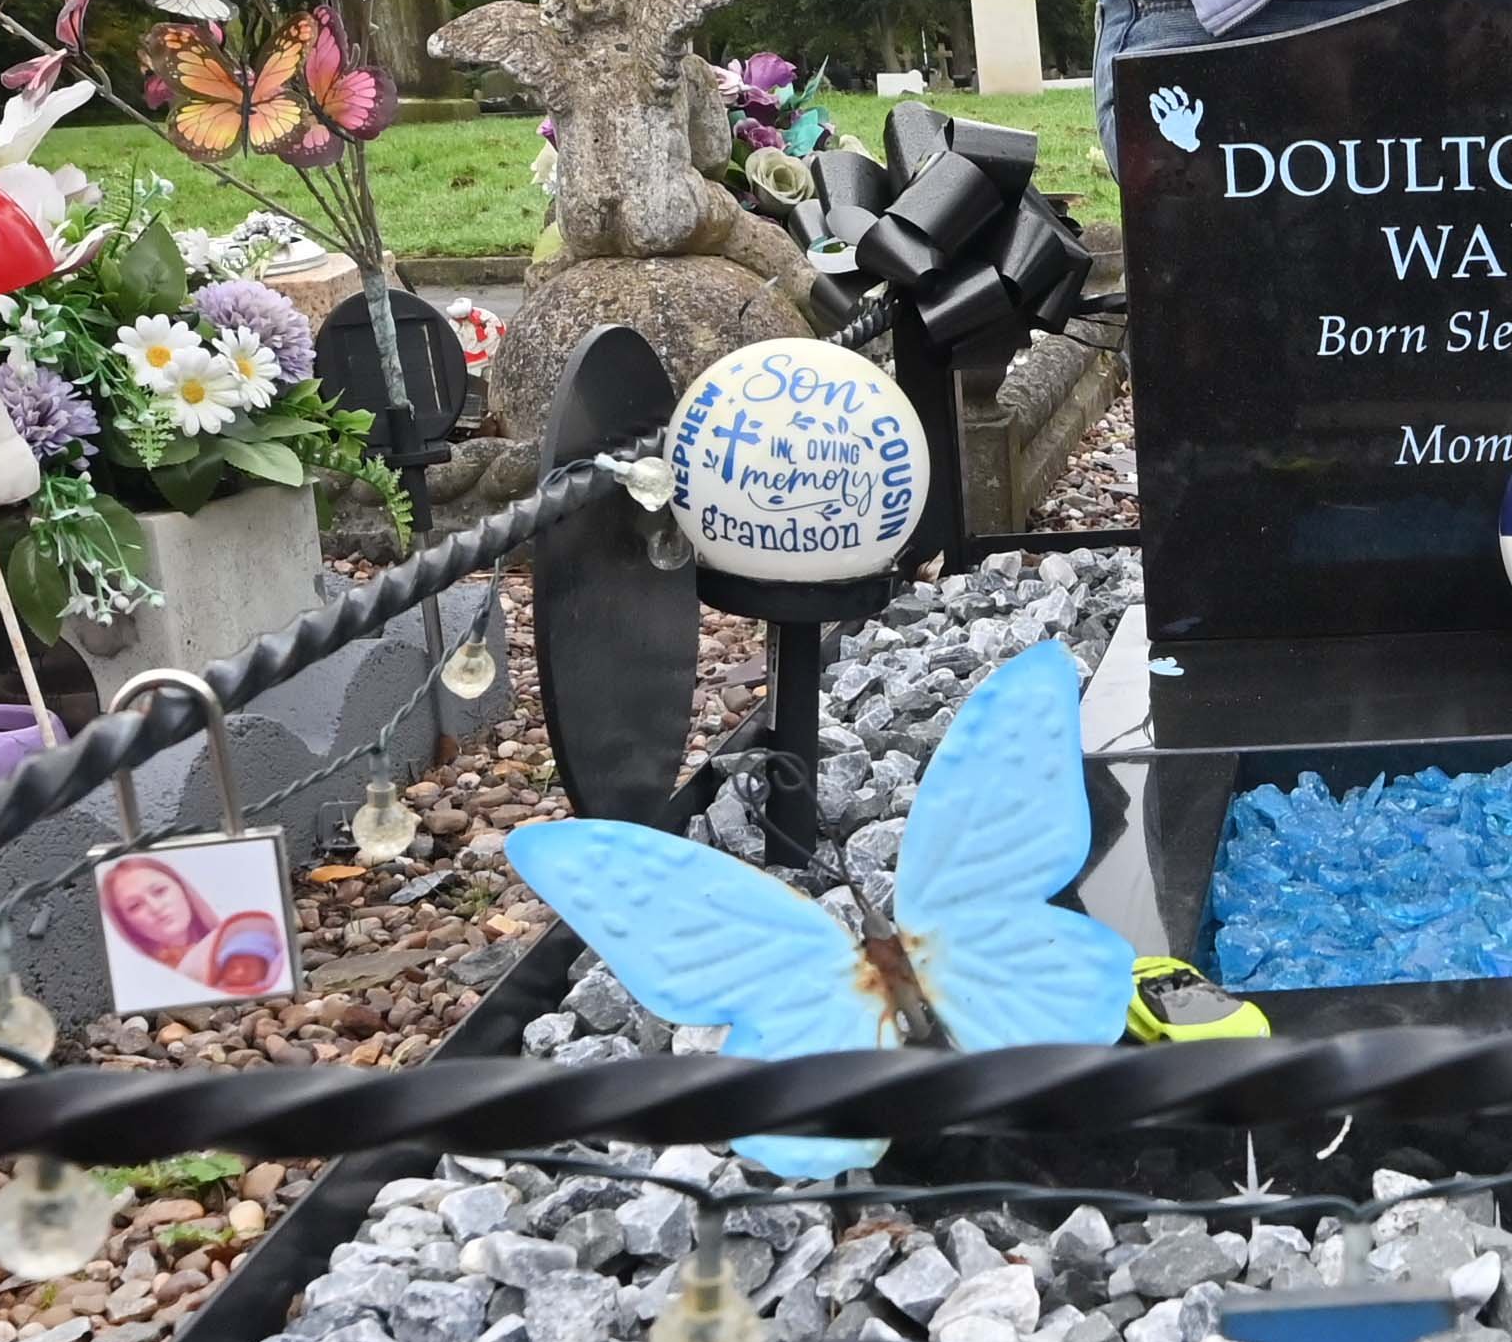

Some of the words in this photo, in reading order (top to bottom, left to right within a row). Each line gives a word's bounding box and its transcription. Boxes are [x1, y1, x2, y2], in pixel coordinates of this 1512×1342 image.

[1317, 315, 1427, 356] Born
[743, 354, 864, 414] Son
[672, 381, 723, 510] NEPHEW
[740, 465, 879, 517] memory
[871, 415, 913, 542] COUSIN
[702, 504, 861, 552] grandson
